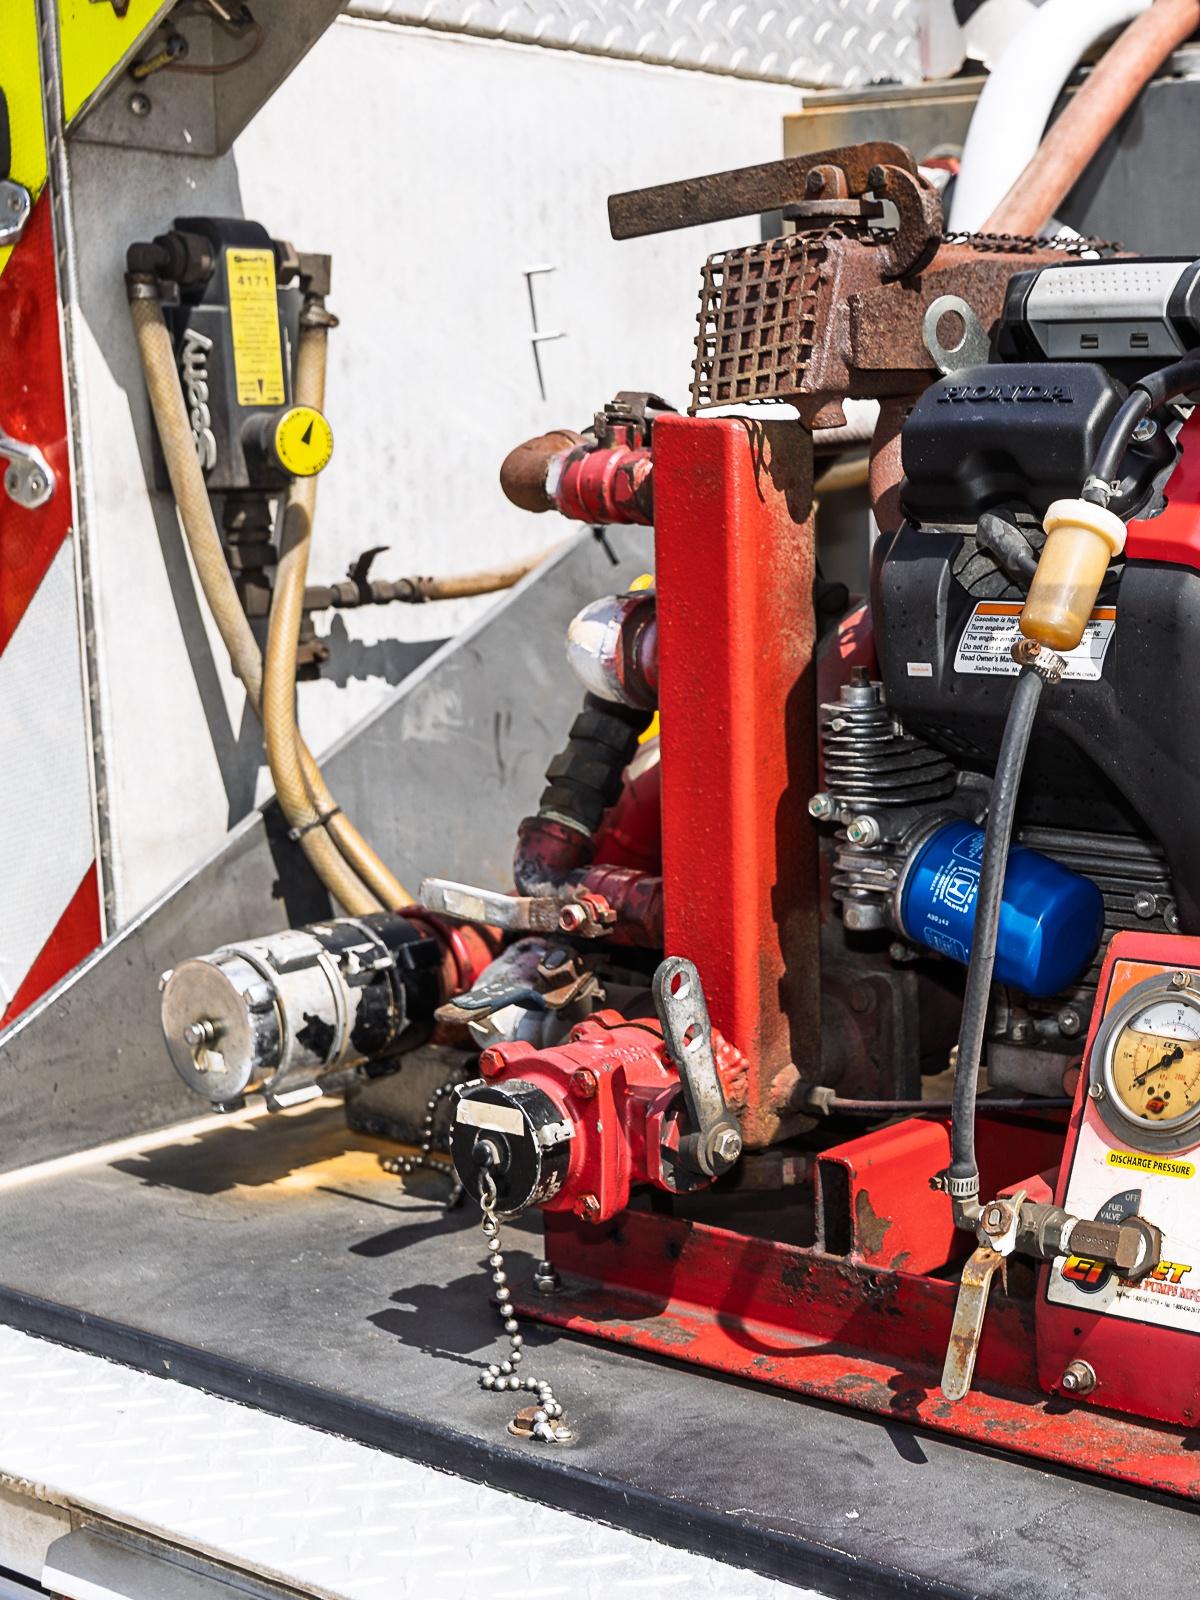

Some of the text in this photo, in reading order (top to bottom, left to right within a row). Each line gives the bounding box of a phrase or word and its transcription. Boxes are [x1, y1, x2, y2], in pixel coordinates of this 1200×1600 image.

[238, 275, 269, 286] 4171
[937, 385, 1075, 403] HONDA
[960, 653, 1015, 663] Read Owner's Man
[1110, 1154, 1191, 1175] DISCHARGE PRESSURE
[1125, 1193, 1139, 1202] OFF
[1108, 1203, 1124, 1212] FUEL
[1100, 1211, 1121, 1220] VALVE
[1151, 1260, 1192, 1284] ET
[1145, 1280, 1177, 1297] PUMPS
